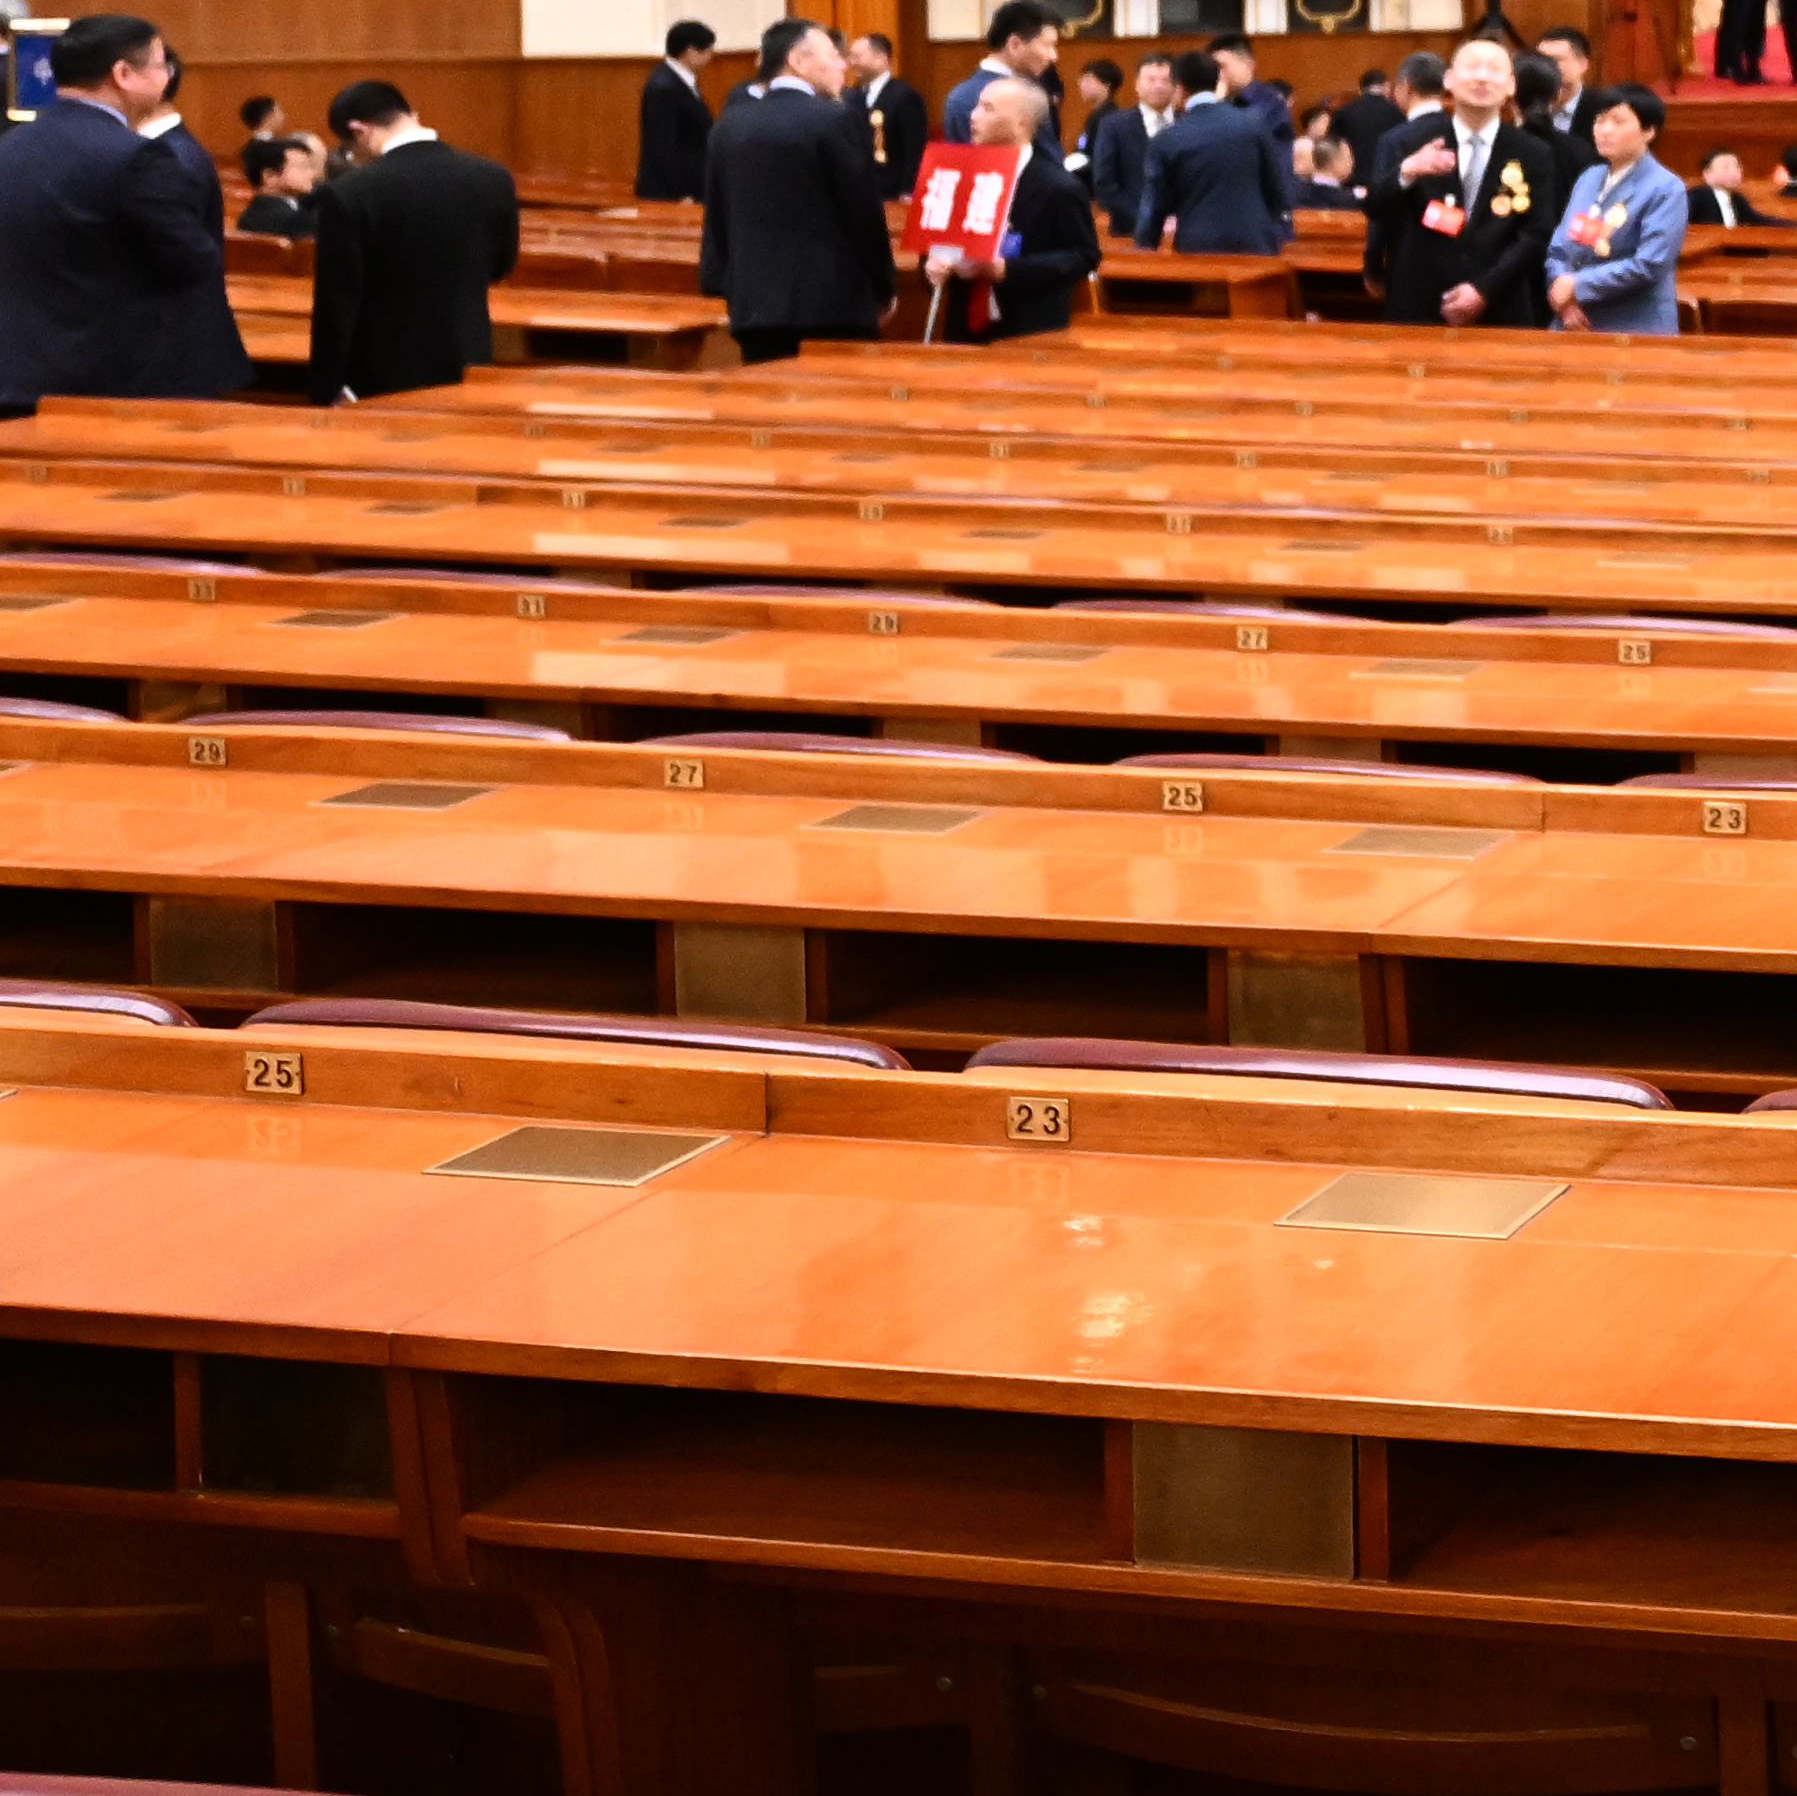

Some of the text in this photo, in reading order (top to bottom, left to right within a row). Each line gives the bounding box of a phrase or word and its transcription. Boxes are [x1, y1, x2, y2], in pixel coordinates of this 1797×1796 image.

[920, 168, 1003, 235] 福建
[1623, 644, 1648, 661] 25
[194, 741, 222, 763] 29
[669, 763, 698, 784] 27
[1168, 786, 1198, 807] 25
[1708, 807, 1741, 829] 23
[253, 1058, 294, 1089] 25
[1016, 1104, 1061, 1135] 23
